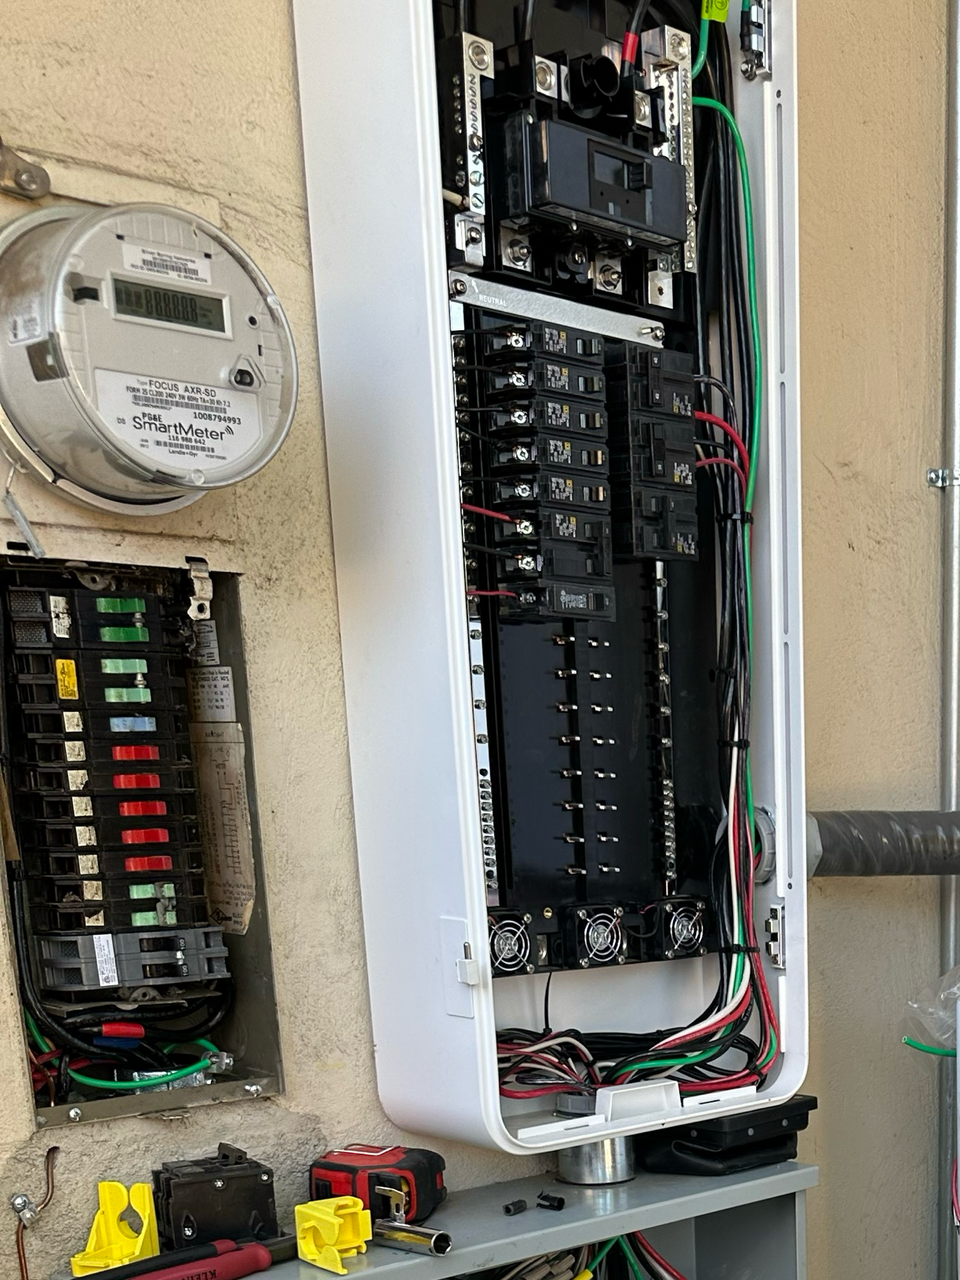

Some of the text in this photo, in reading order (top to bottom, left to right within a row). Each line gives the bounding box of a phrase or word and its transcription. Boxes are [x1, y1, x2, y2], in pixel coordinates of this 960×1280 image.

[479, 294, 507, 307] NEUTRAL
[149, 380, 180, 393] FOCUS
[184, 385, 217, 398] AXR-SD
[142, 412, 163, 423] PG&E
[193, 412, 242, 425] 1008794993
[133, 416, 226, 441] SmartMeter
